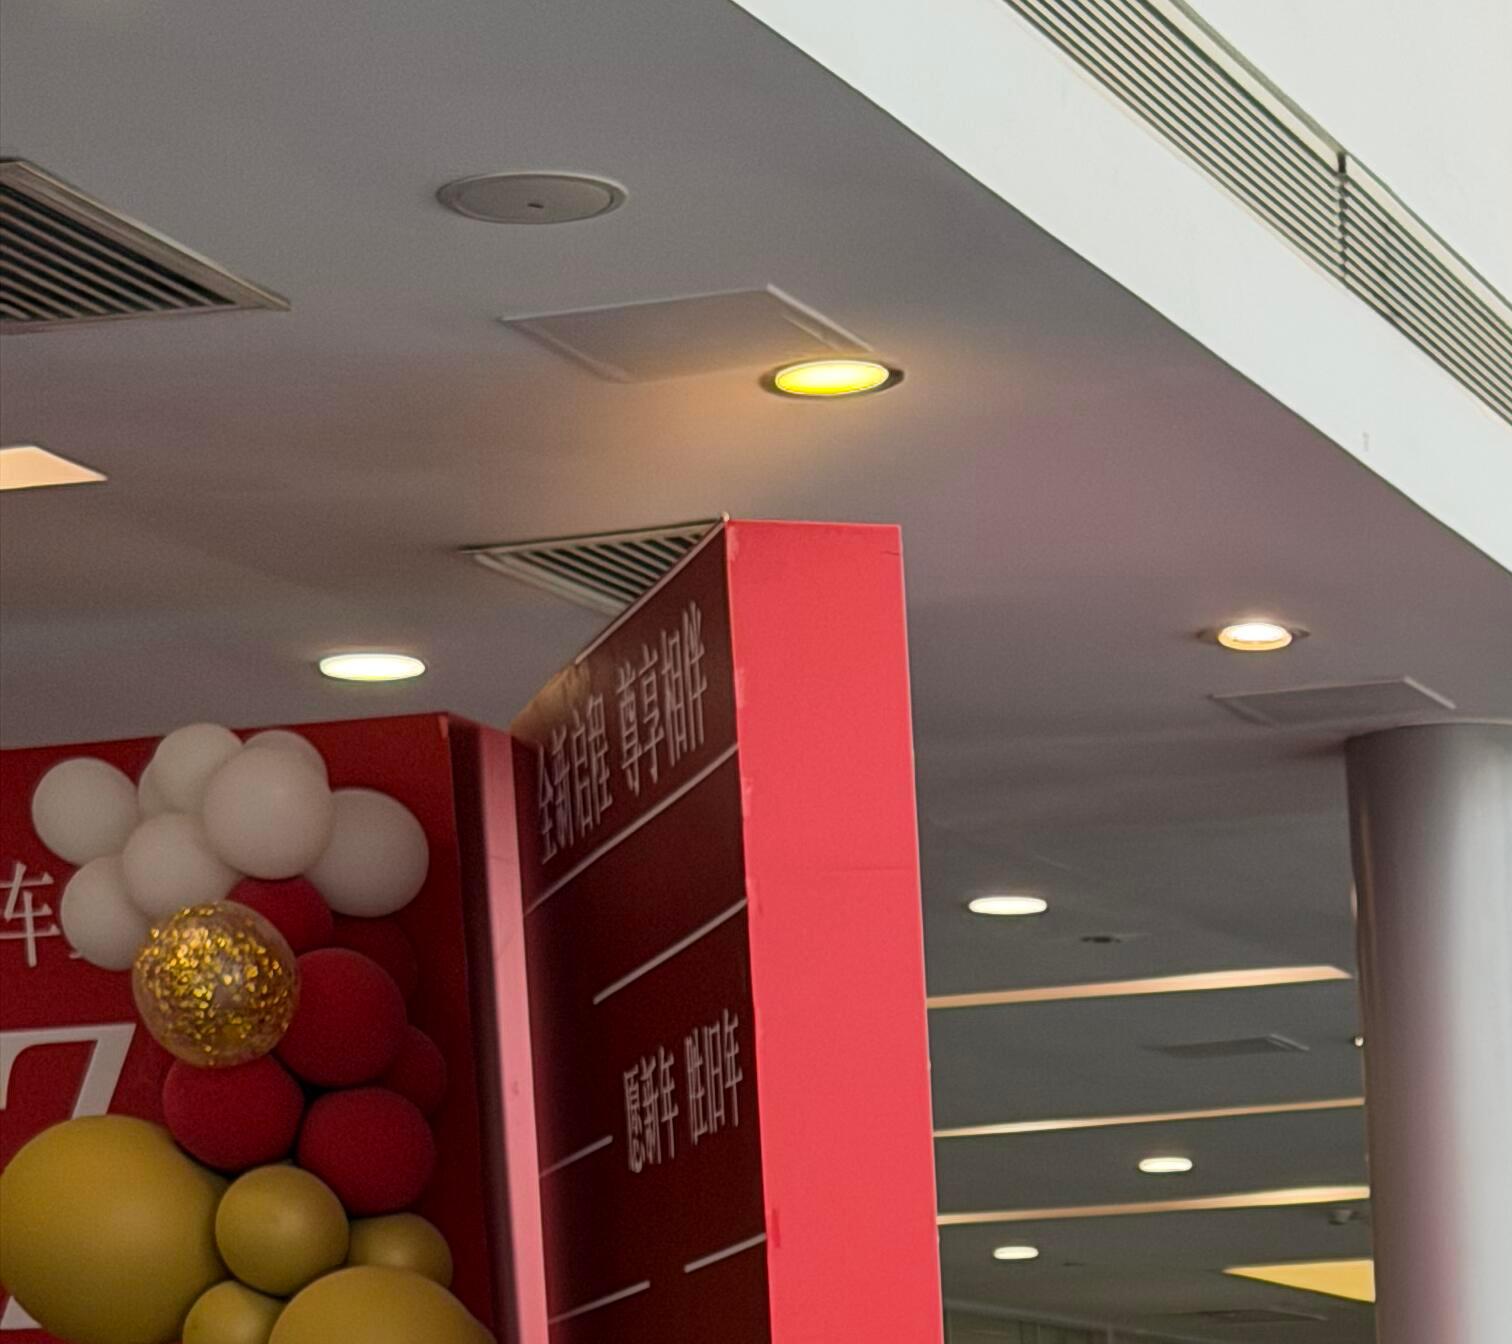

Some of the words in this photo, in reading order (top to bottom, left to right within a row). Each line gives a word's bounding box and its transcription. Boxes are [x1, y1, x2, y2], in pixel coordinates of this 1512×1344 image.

[616, 600, 708, 797] 尊享相伴
[623, 1044, 680, 1174] 愿新年
[684, 1008, 744, 1146] 胜旧年
